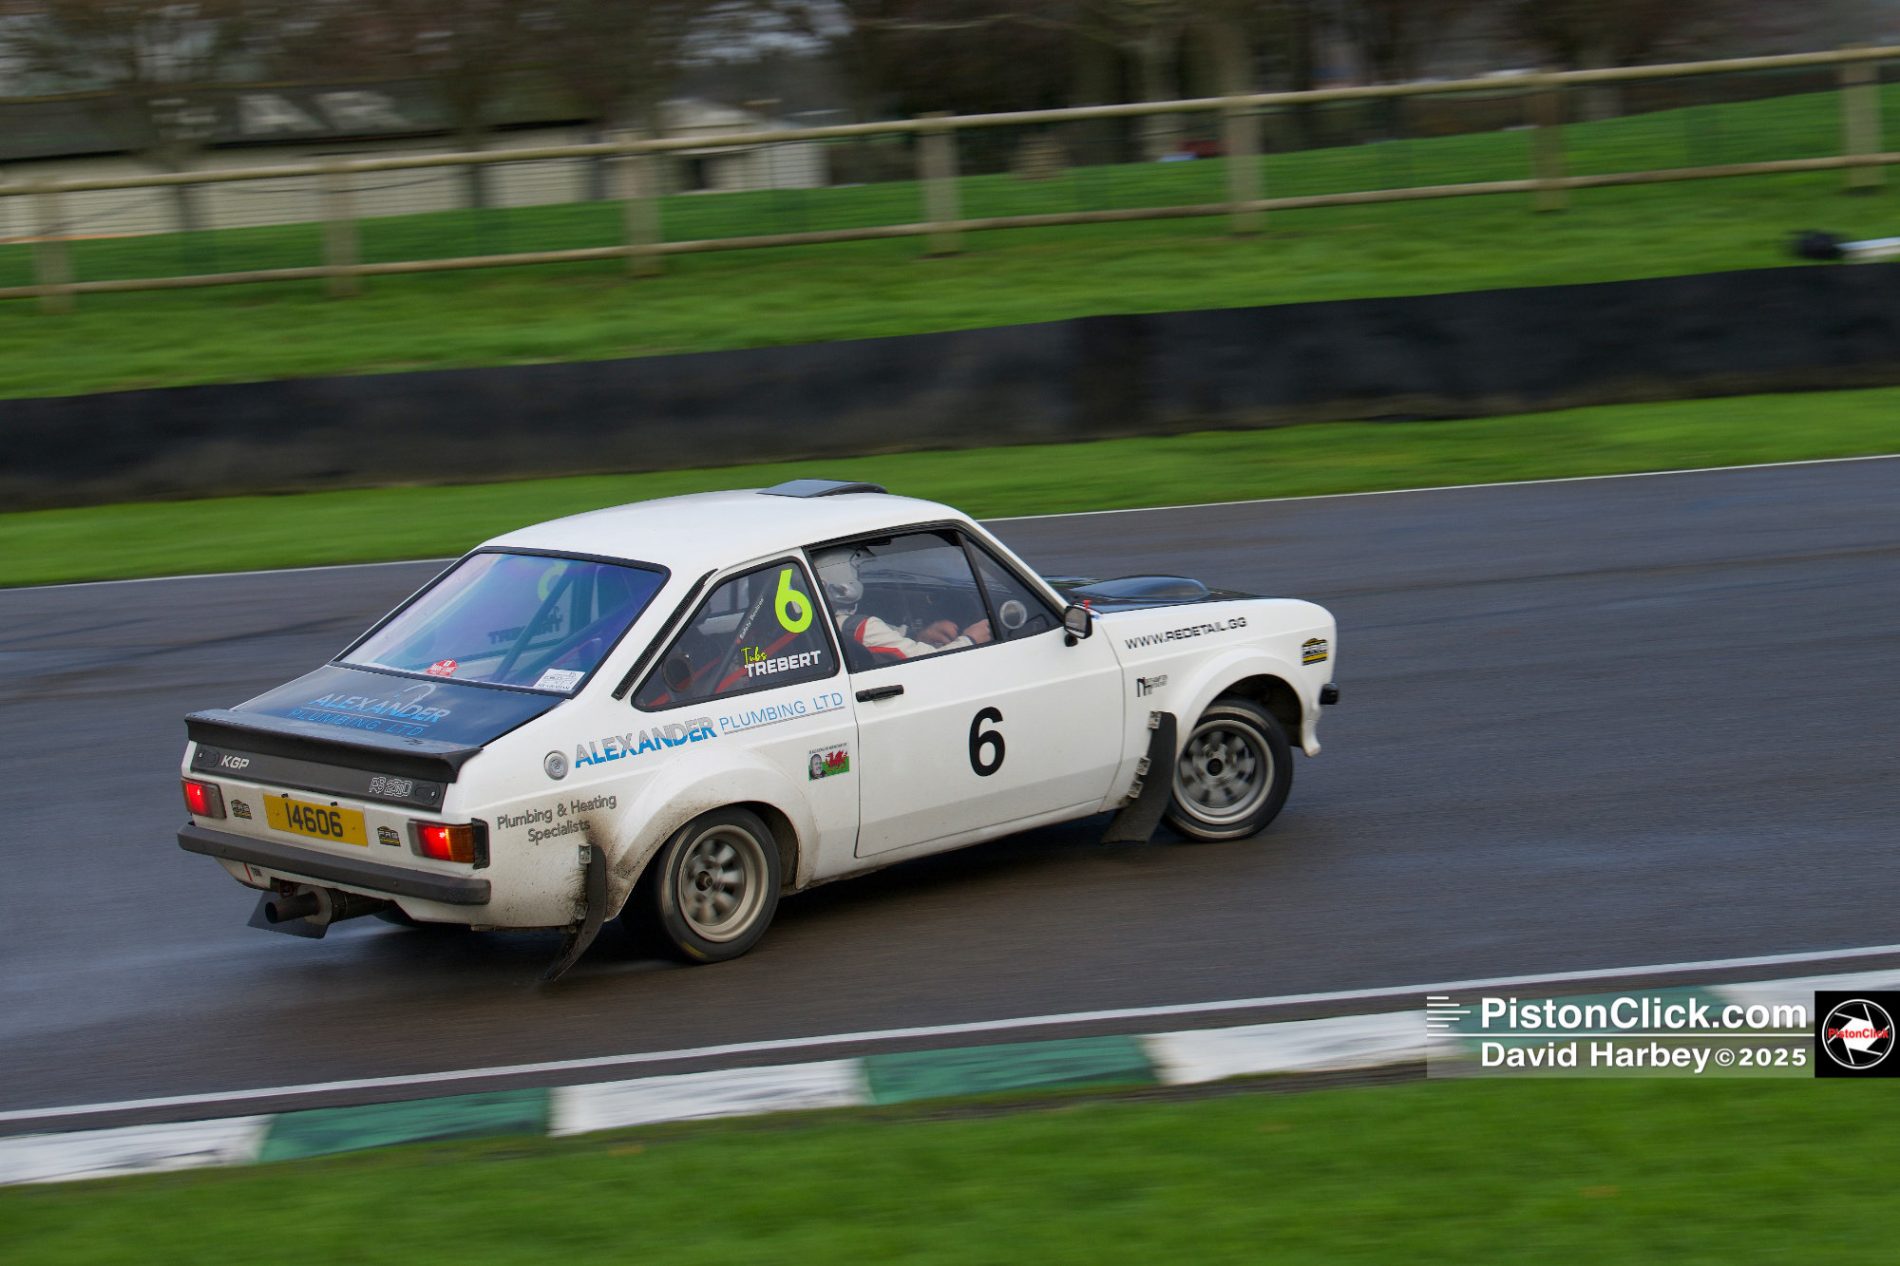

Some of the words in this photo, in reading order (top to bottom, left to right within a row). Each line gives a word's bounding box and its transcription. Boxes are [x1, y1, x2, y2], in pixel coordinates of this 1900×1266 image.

[774, 568, 813, 634] 6
[1124, 617, 1248, 650] WWW.REDETAIL.GG
[741, 646, 767, 663] Tubs
[744, 650, 822, 678] TREBERT
[286, 708, 382, 731] PLUMBING
[387, 724, 424, 737] LTD
[308, 693, 450, 723] ALEXANDER
[574, 716, 718, 769] ALEXANDER
[719, 700, 807, 732] PLUMBING
[814, 692, 844, 711] LTD
[968, 706, 1006, 777] 6
[221, 754, 250, 770] KGP
[284, 802, 344, 839] 14606
[496, 806, 553, 831] Plumbing
[557, 801, 568, 818] &
[570, 794, 618, 814] Heating
[528, 818, 591, 846] Specialists
